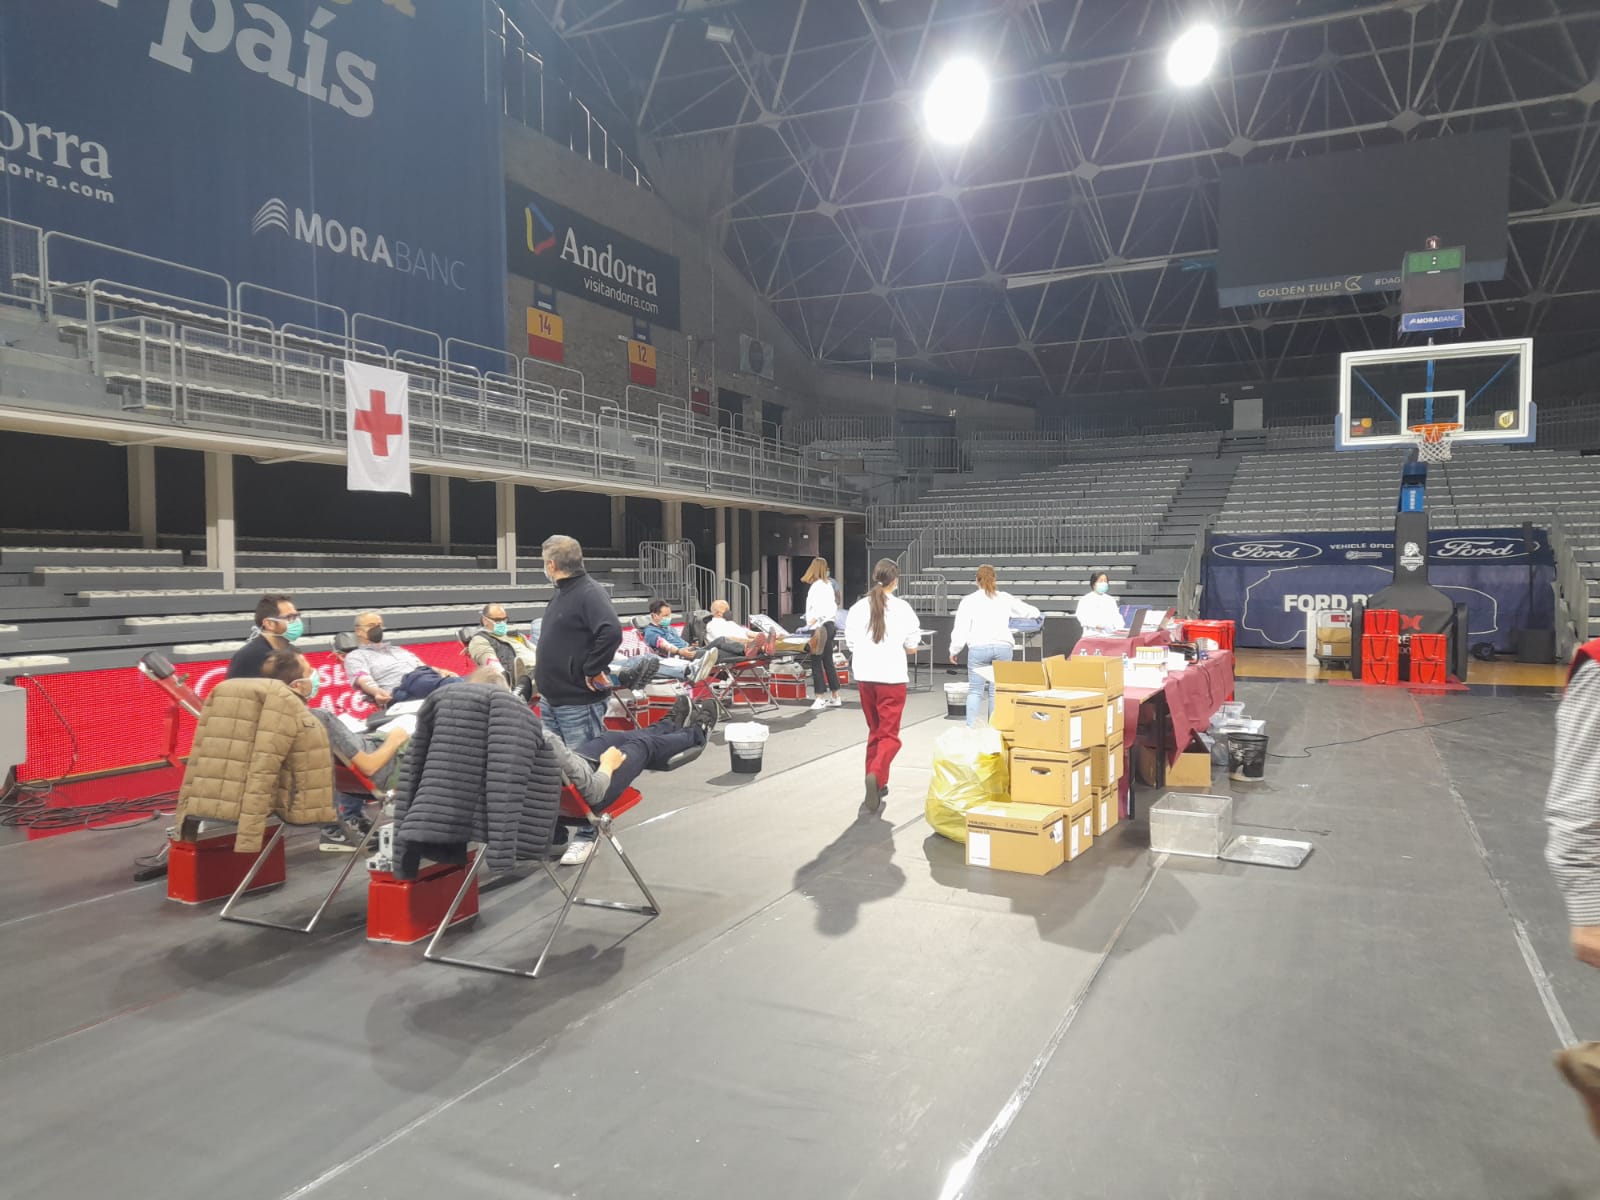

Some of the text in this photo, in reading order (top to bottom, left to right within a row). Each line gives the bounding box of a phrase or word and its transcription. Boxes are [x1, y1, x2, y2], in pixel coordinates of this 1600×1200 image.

[149, 0, 376, 118] país
[295, 207, 465, 291] MORABANC
[560, 227, 658, 297] Andorra
[583, 275, 659, 315] visitandorra.com
[1257, 285, 1305, 298] GOLDEN
[1309, 281, 1342, 293] TULIP
[539, 314, 552, 336] 14
[1416, 314, 1460, 324] MORABANC
[637, 345, 648, 363] 12
[1231, 543, 1301, 558] Ford
[1437, 540, 1515, 556] Ford
[1284, 594, 1348, 612] FORD
